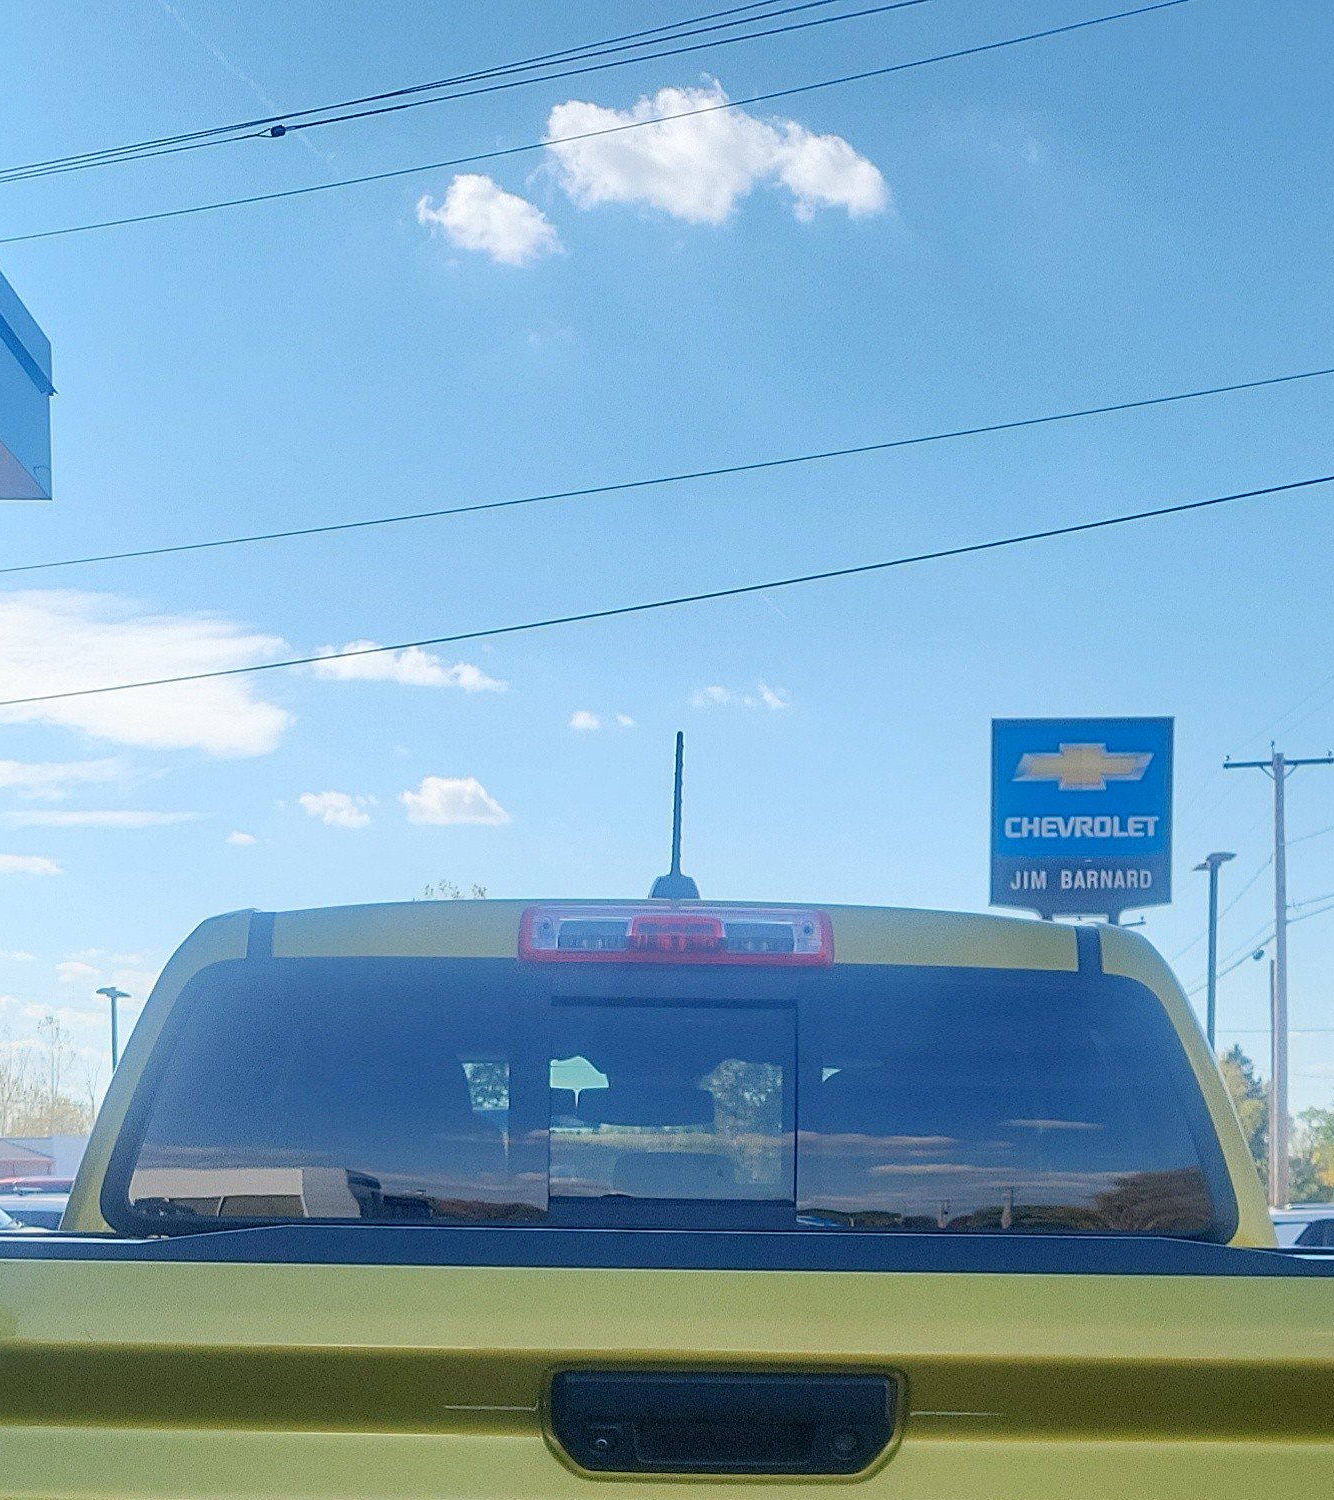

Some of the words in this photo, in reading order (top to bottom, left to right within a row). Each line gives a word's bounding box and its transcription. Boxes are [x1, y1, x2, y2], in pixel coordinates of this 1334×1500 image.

[1005, 816, 1159, 838] CHEVROLET
[1010, 870, 1048, 890] JIM
[1061, 869, 1153, 889] BARNARD
